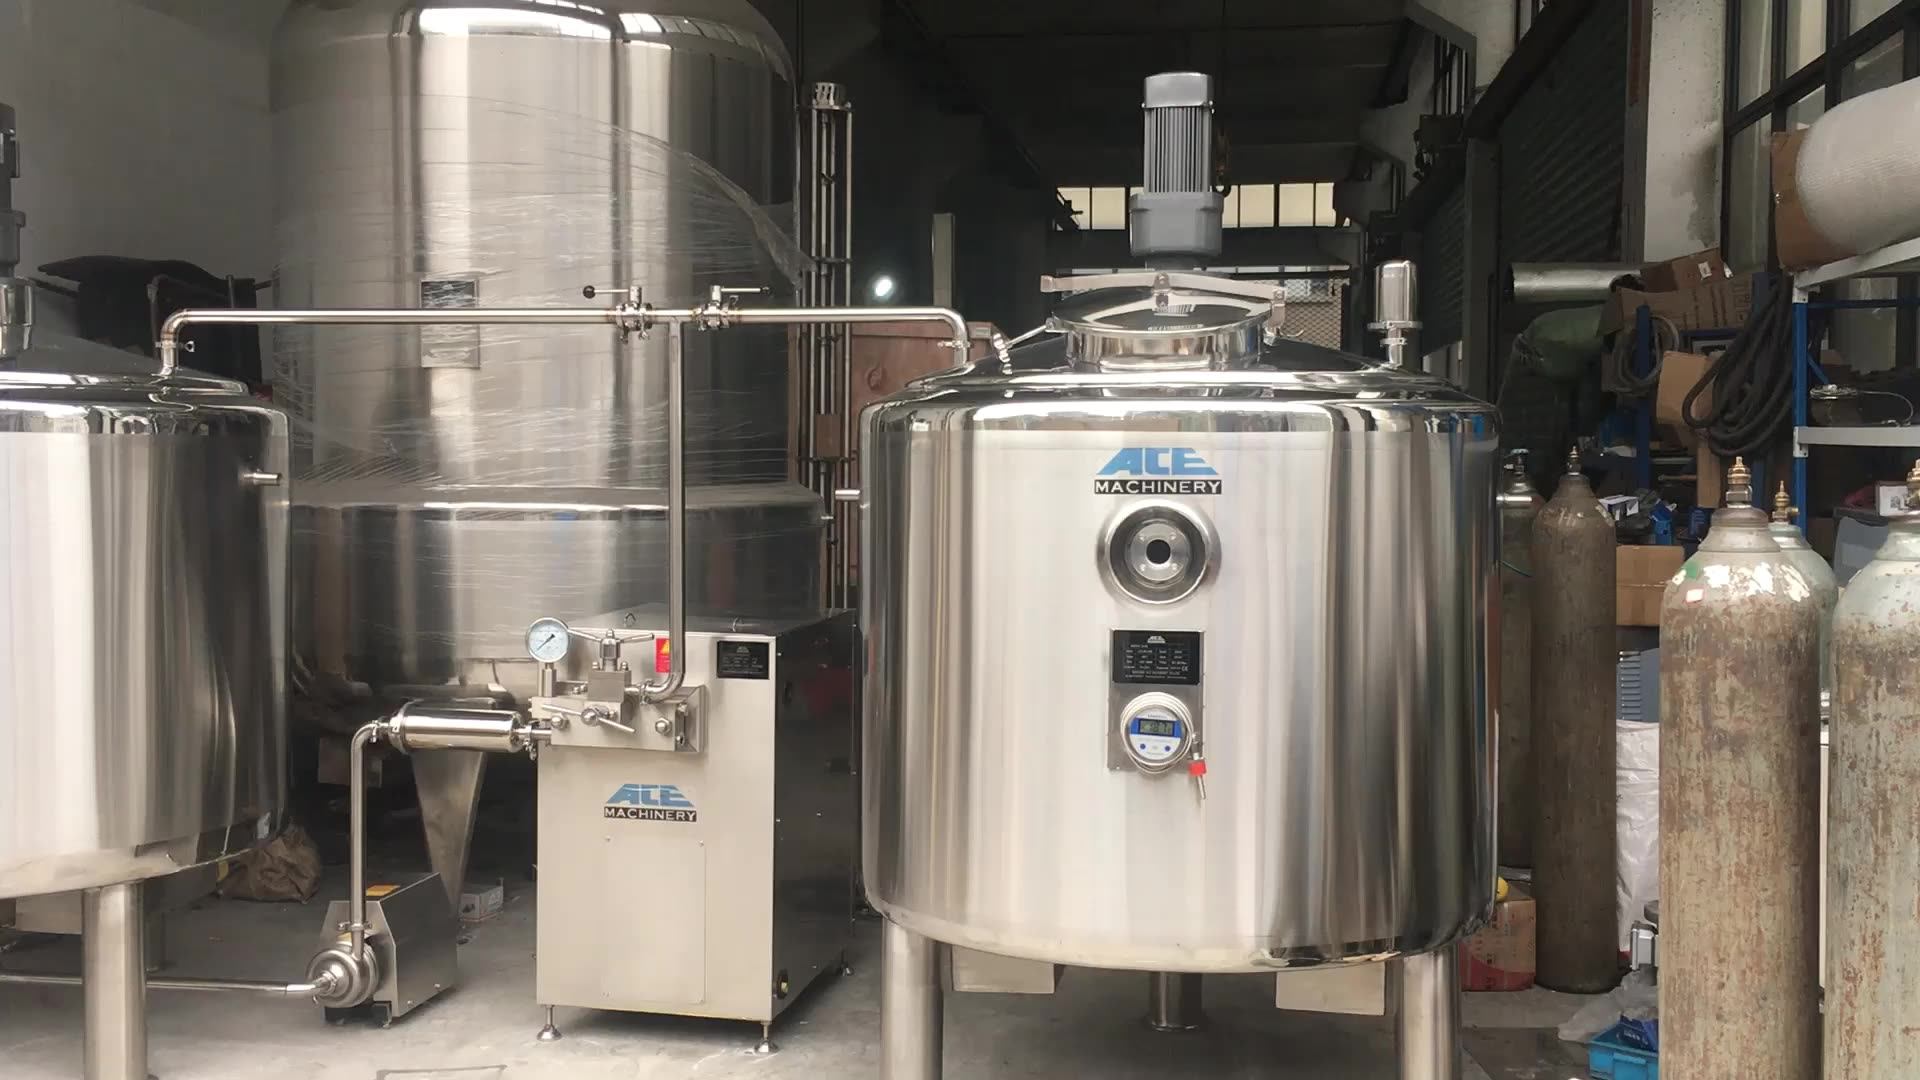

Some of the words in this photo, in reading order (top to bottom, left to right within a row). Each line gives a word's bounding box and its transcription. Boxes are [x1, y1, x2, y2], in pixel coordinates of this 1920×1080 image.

[1097, 447, 1219, 476] ACE
[1095, 480, 1221, 494] MACHINERY
[606, 783, 695, 807] ACE
[604, 807, 696, 821] MACHINERY
